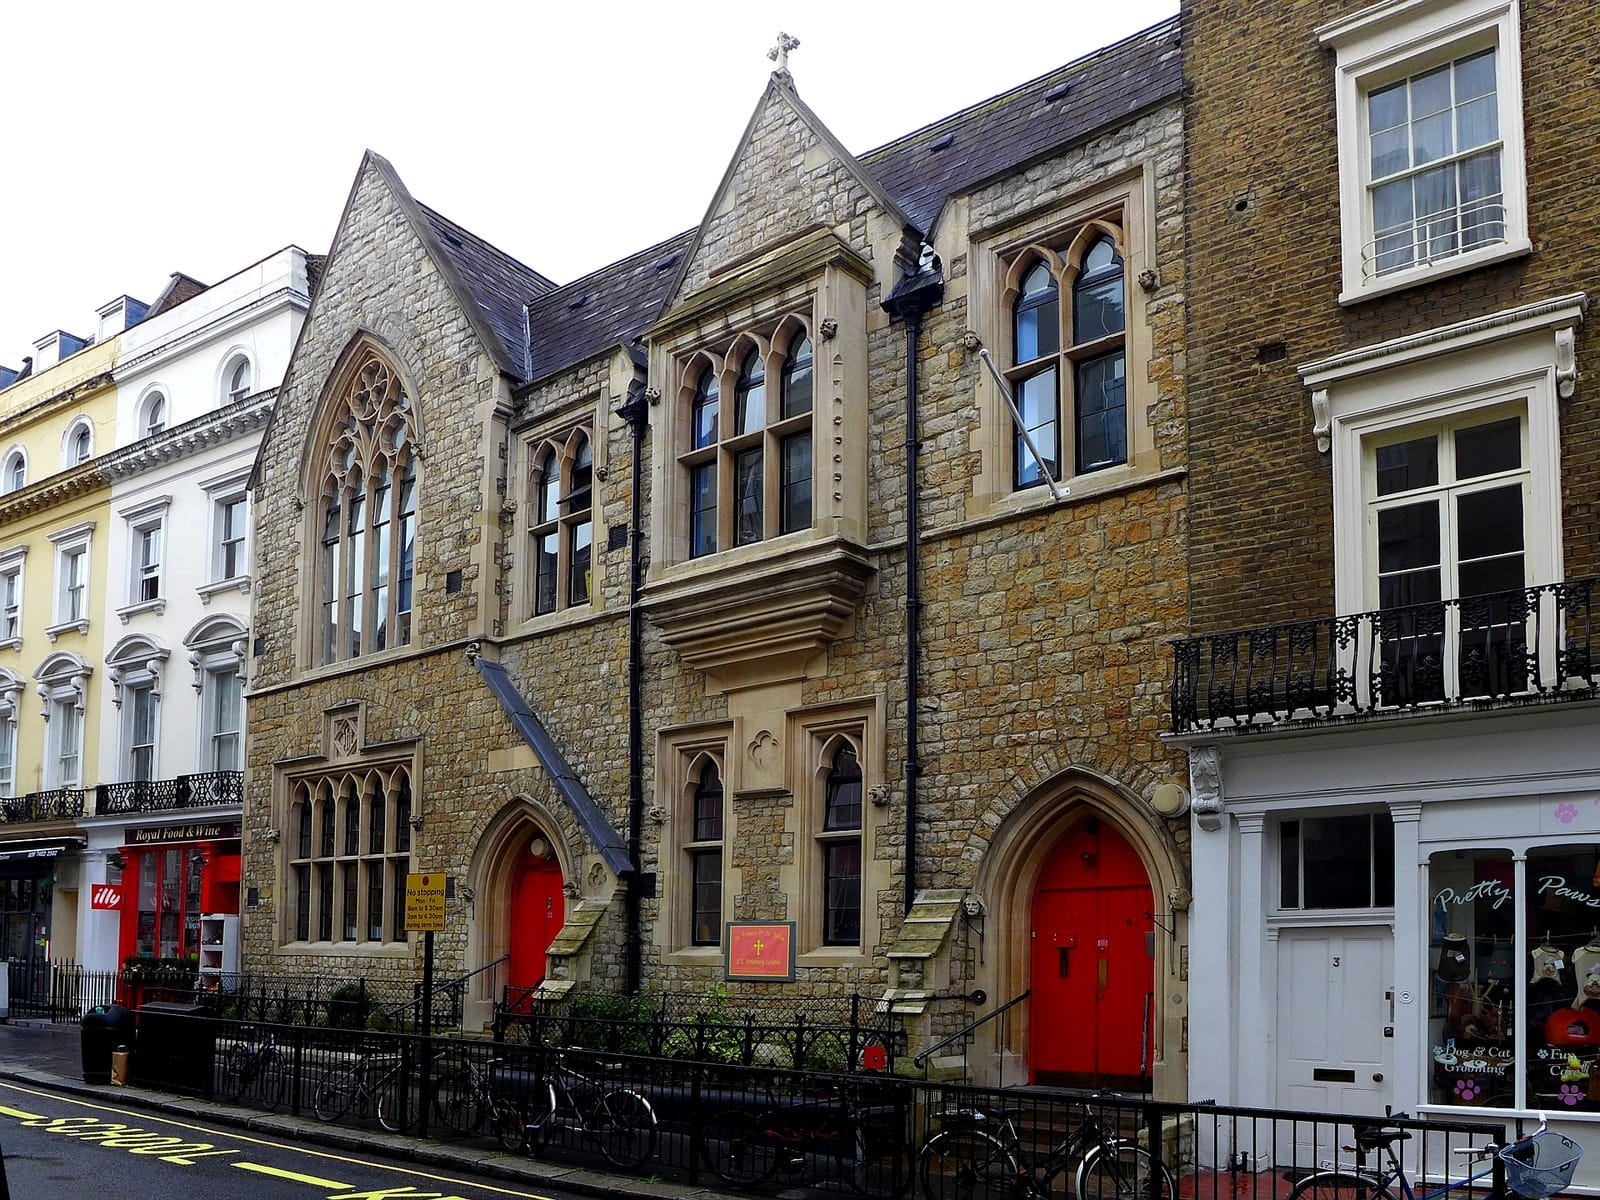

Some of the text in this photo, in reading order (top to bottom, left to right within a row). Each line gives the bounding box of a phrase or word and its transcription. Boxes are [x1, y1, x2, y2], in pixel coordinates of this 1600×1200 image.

[136, 829, 161, 843] Royal
[163, 826, 185, 839] Food
[186, 826, 194, 837] &
[195, 824, 221, 837] Wine
[93, 888, 121, 908] illy
[407, 888, 444, 897] No stopping
[1434, 879, 1512, 912] Pretty
[1538, 876, 1600, 907] Paws
[1333, 957, 1340, 967] 3
[1445, 1045, 1511, 1058] Dog & Cat
[1444, 1063, 1505, 1076] Grooming
[20, 1117, 241, 1166] SCHOOL
